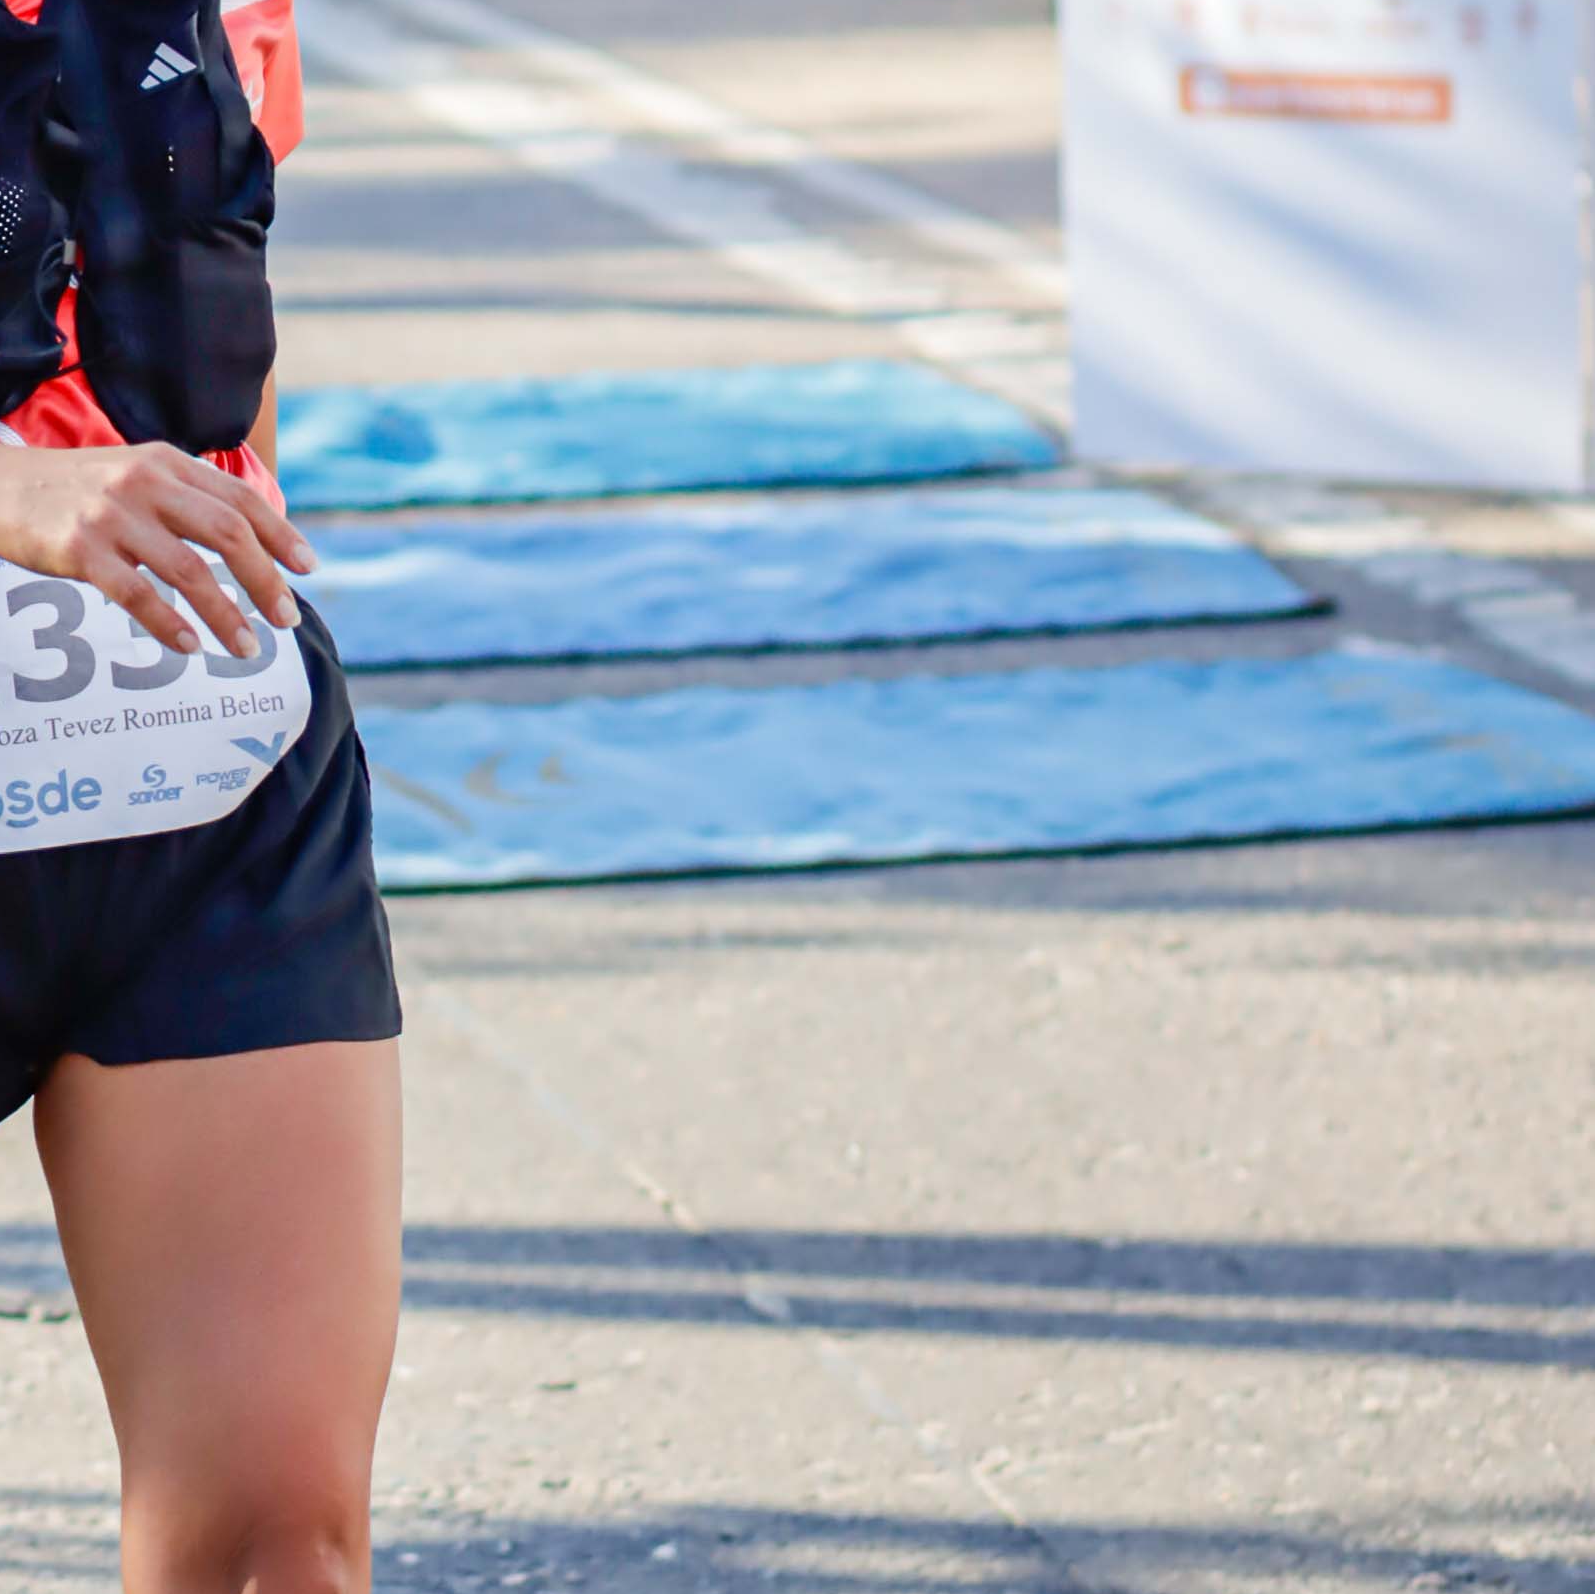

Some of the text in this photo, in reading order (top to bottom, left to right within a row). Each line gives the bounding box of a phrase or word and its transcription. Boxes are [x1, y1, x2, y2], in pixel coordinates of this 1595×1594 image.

[45, 716, 115, 740] Tevez
[123, 701, 213, 732] Romina
[220, 692, 286, 719] Belen
[195, 766, 252, 786] POWER
